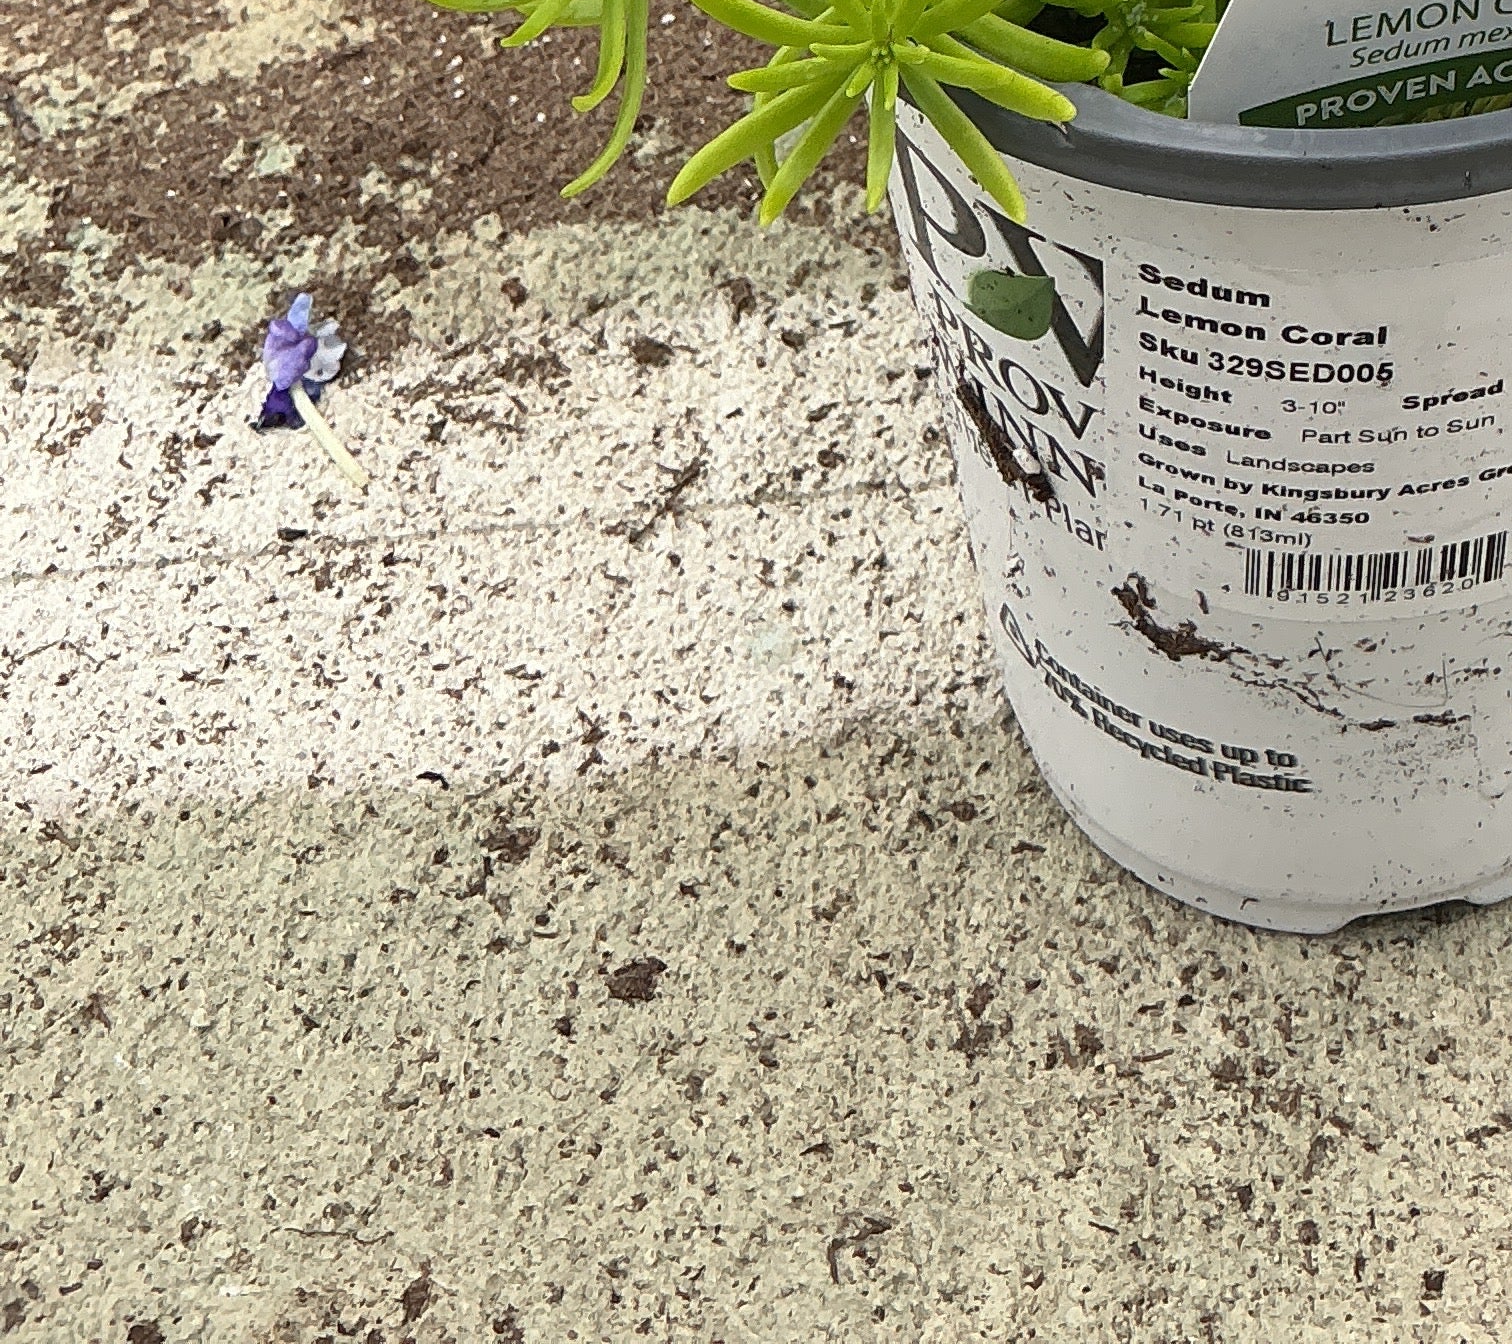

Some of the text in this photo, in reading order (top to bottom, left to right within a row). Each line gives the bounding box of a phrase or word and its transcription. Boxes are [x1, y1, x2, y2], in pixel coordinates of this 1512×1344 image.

[1348, 35, 1452, 70] Sedum
[1294, 68, 1458, 127] PROVEN
[1137, 262, 1271, 309] Sedum
[1136, 294, 1388, 347] Lemon Coral
[1138, 330, 1395, 384] Sku 329SED005
[1138, 365, 1234, 405] Height
[1401, 378, 1505, 412] Spread
[1137, 394, 1496, 445] Exposure Part Sun to Sun
[1137, 421, 1376, 478] Uses Landscapes
[1137, 451, 1217, 487] Grown
[1223, 476, 1254, 496] by
[1260, 481, 1392, 502] Kingsbury
[1397, 474, 1472, 498] Acres
[1137, 474, 1371, 526] La Porte, IN 46350
[1191, 516, 1217, 534] pt
[1223, 521, 1314, 549] (813ml)
[1091, 705, 1209, 776] Recycled
[1212, 760, 1314, 793] Plastic
[1148, 719, 1215, 754] uses
[1220, 742, 1260, 767] up
[1264, 748, 1299, 768] to
